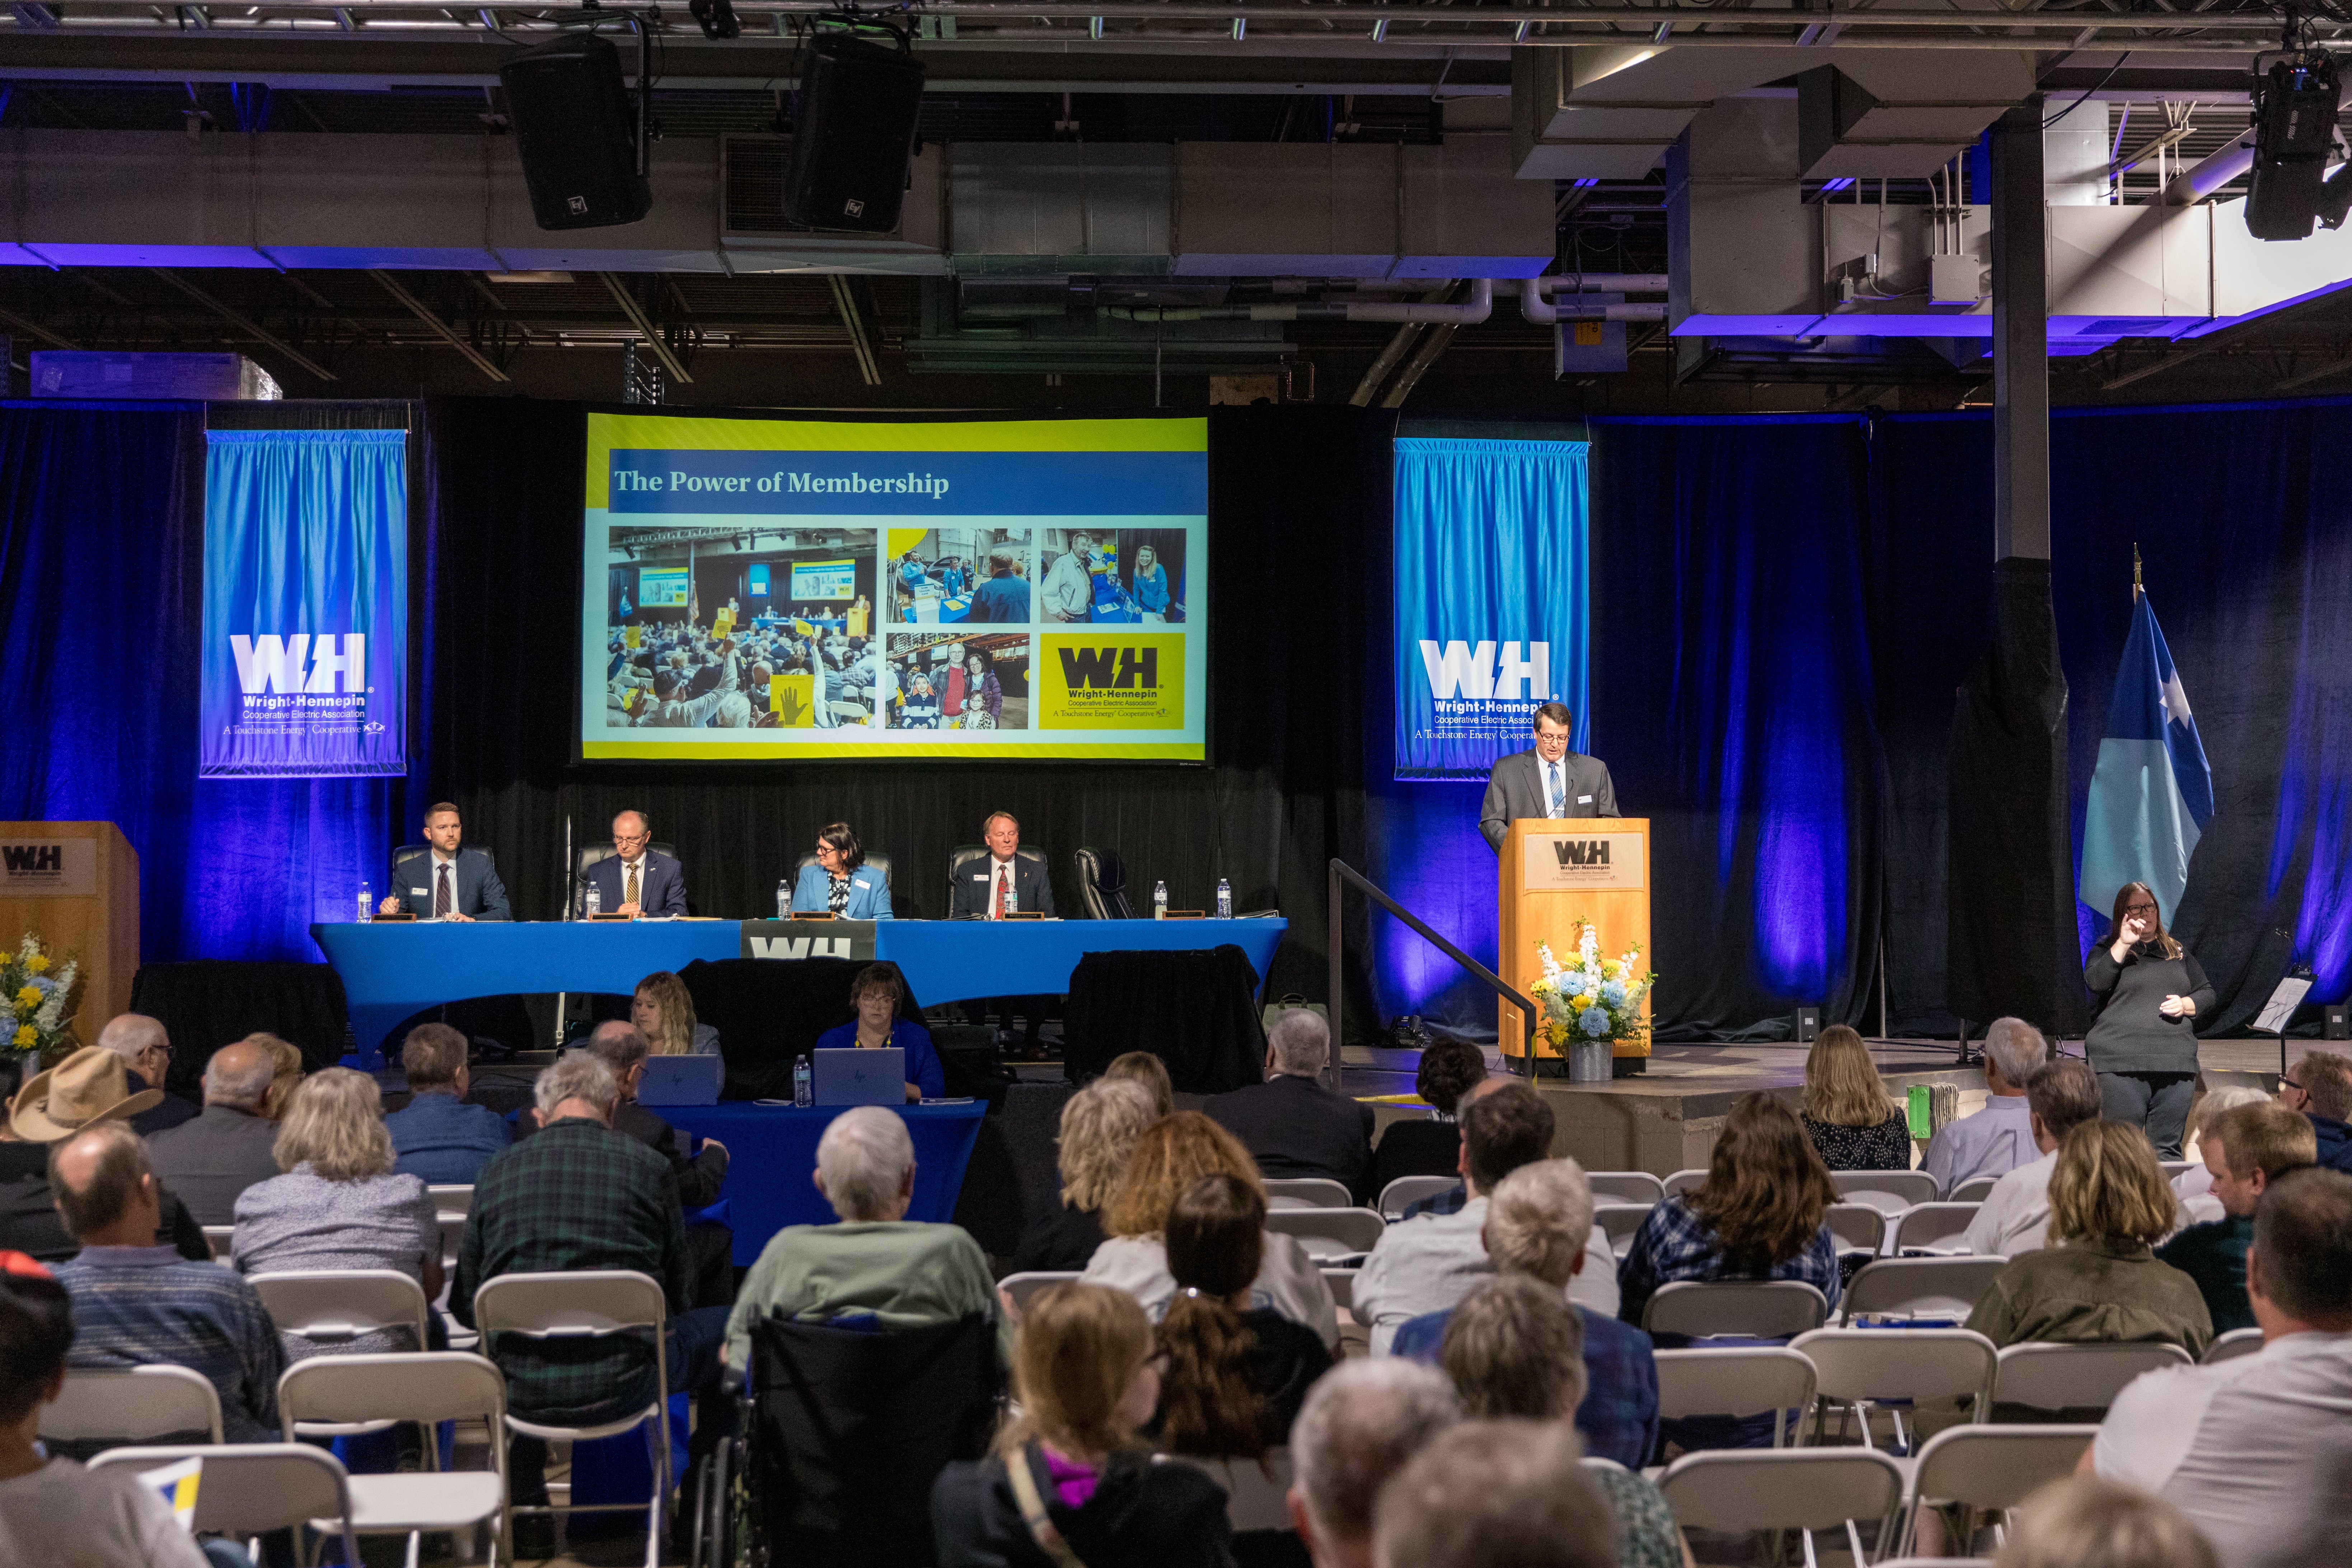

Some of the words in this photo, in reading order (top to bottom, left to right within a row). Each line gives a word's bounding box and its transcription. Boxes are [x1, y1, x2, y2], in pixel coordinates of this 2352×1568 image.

[615, 470, 662, 491] The
[670, 471, 750, 492] Power
[757, 471, 784, 492] of
[788, 472, 949, 499] Membership
[1068, 690, 1157, 699] Wright-Hennepin
[243, 694, 365, 710] Wright-Hennepin
[1434, 701, 1544, 715] Wright-Hennepi
[243, 710, 290, 720] Cooperative
[292, 710, 320, 719] Electric
[322, 710, 365, 718] Association
[1434, 715, 1479, 725] Cooperative
[1481, 715, 1507, 724] Electric
[1508, 716, 1533, 724] Associ
[223, 725, 231, 734] A
[234, 725, 278, 734] Touchstone
[312, 724, 361, 735] Cooperative
[1415, 730, 1423, 738] A
[1424, 729, 1467, 739] Touchstone
[1500, 730, 1536, 741] Coopera
